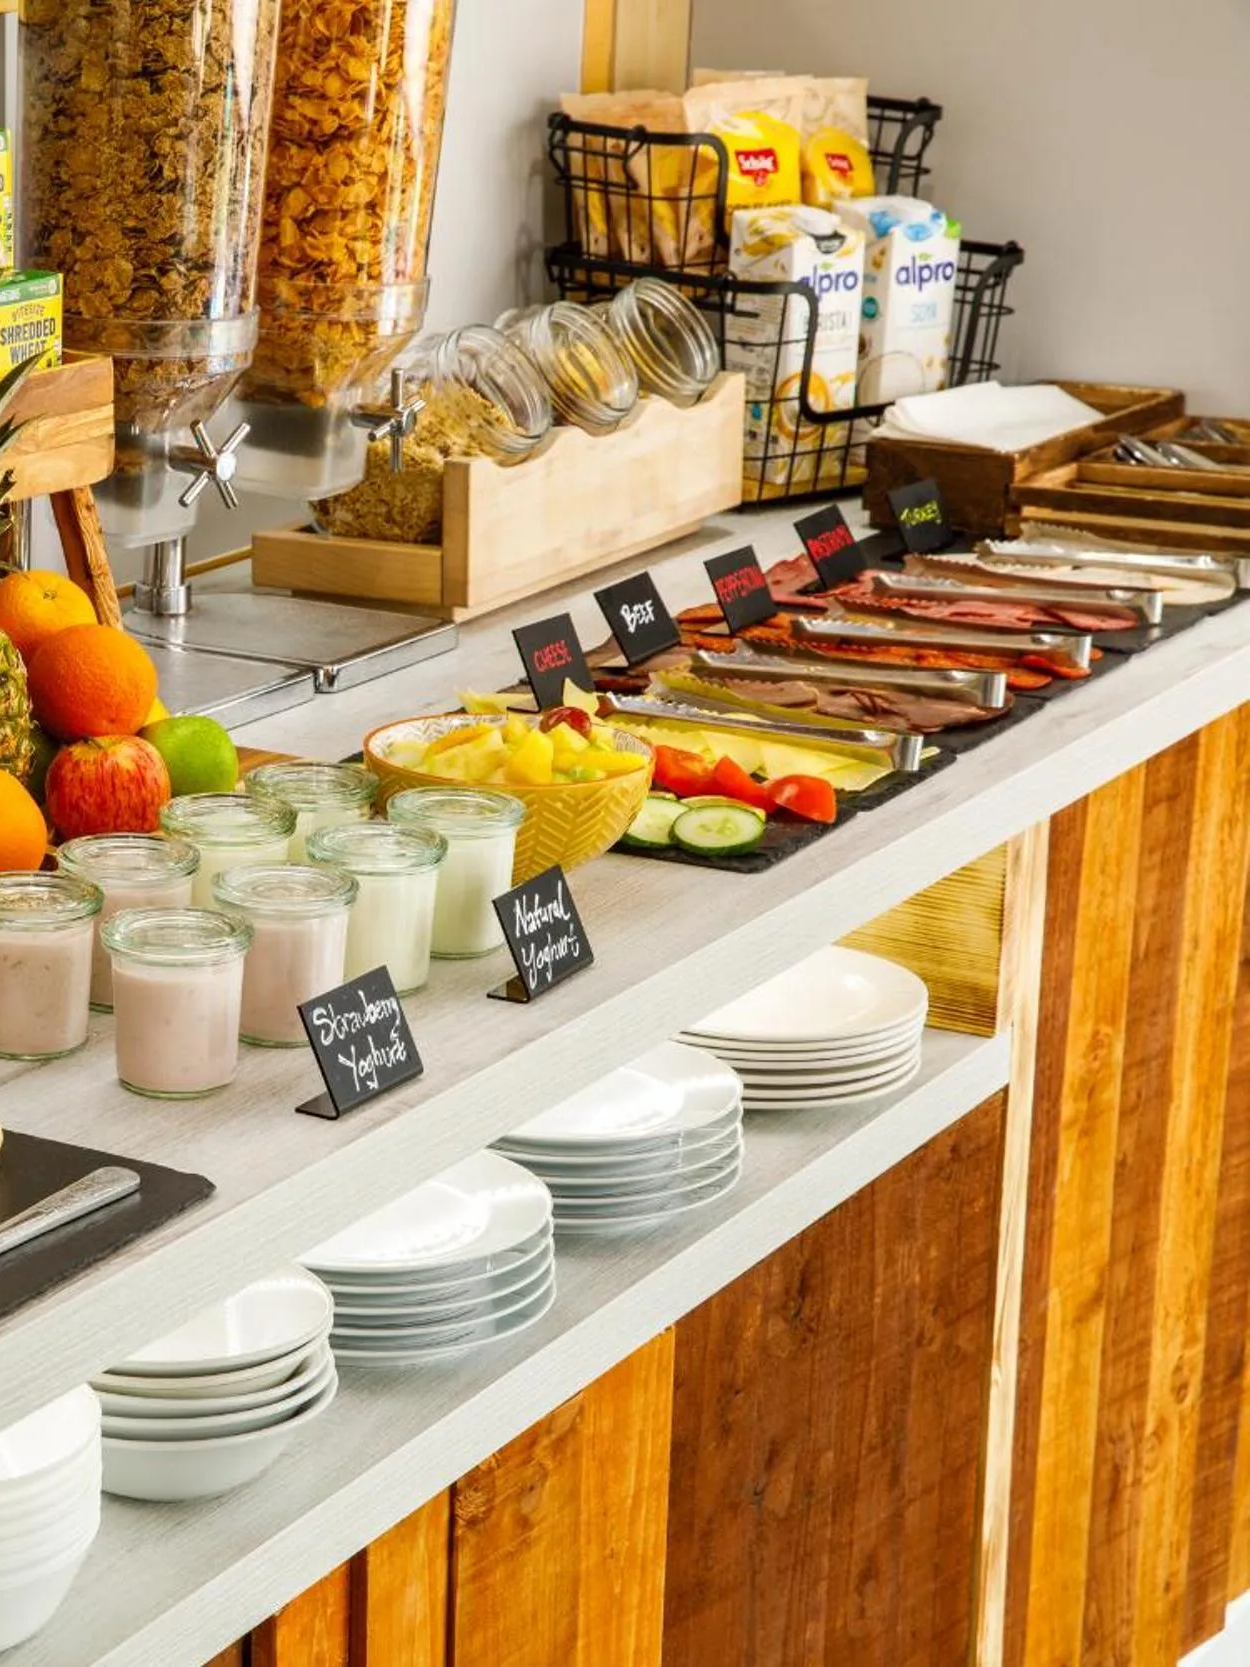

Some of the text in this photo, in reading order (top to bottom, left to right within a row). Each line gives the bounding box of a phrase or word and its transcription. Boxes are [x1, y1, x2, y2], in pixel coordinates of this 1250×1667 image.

[896, 255, 955, 293] alpro
[0, 318, 56, 346] SHREDDED
[620, 600, 655, 634] BEEF
[533, 640, 572, 673] CHEESE
[515, 880, 571, 938] Natural
[521, 923, 579, 989] Yoghurt
[338, 1035, 406, 1092] Yoghurt
